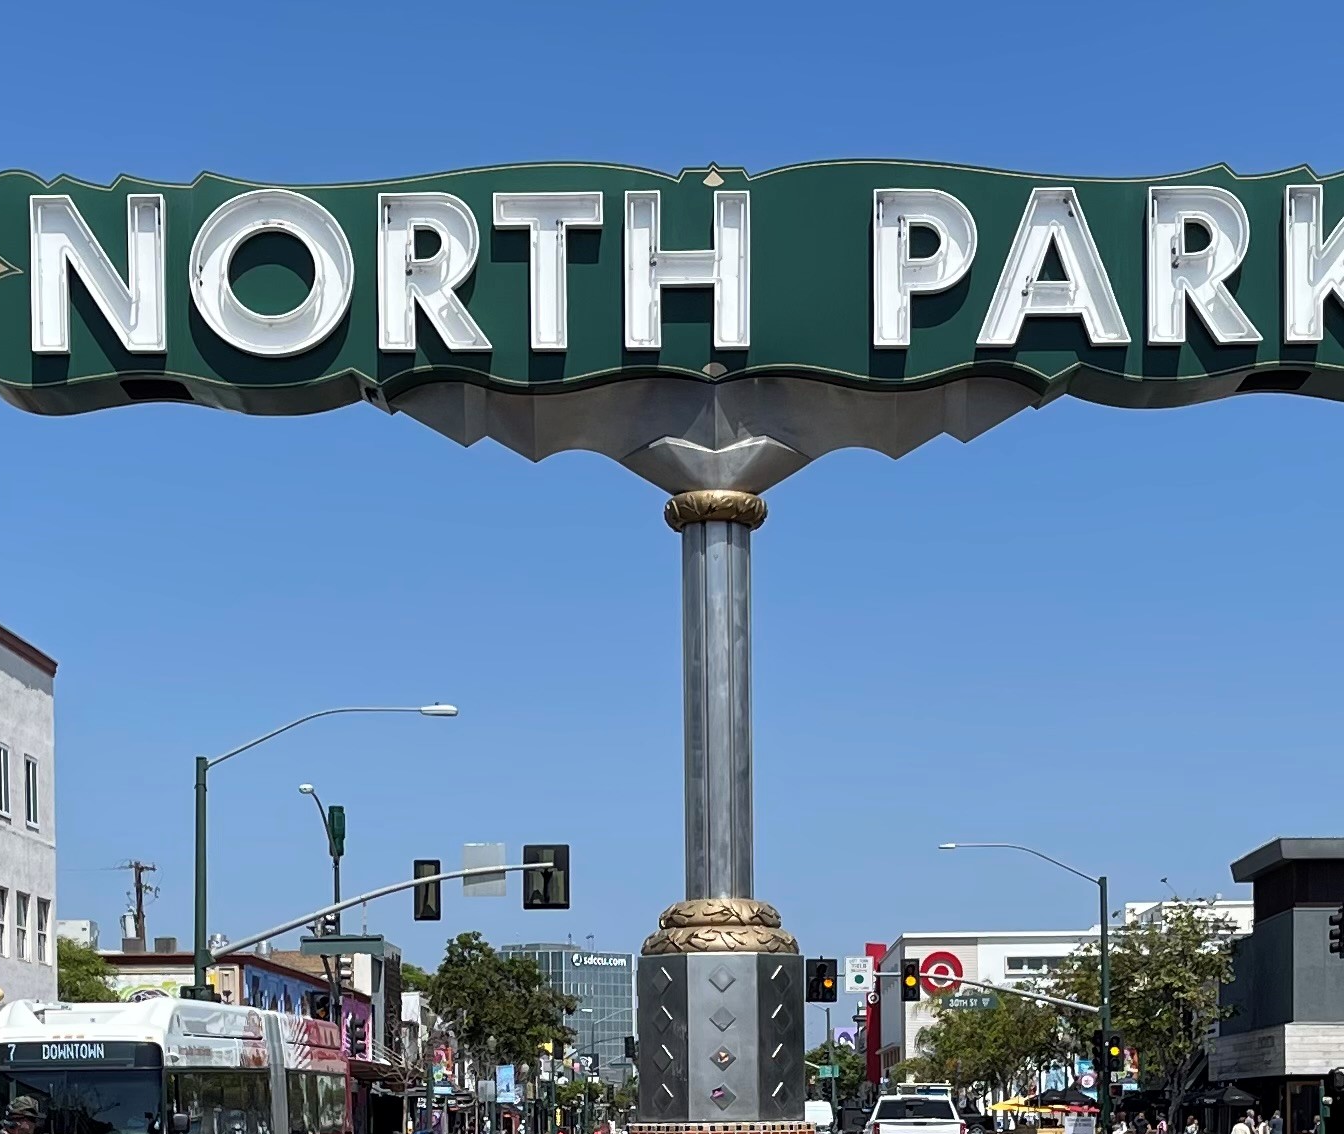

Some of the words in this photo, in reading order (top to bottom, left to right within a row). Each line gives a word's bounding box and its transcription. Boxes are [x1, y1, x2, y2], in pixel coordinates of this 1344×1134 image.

[29, 188, 752, 357] NORTH
[583, 954, 627, 967] sdccu.com
[8, 1044, 16, 1062] 7
[42, 1043, 105, 1060] DOWNTOWN
